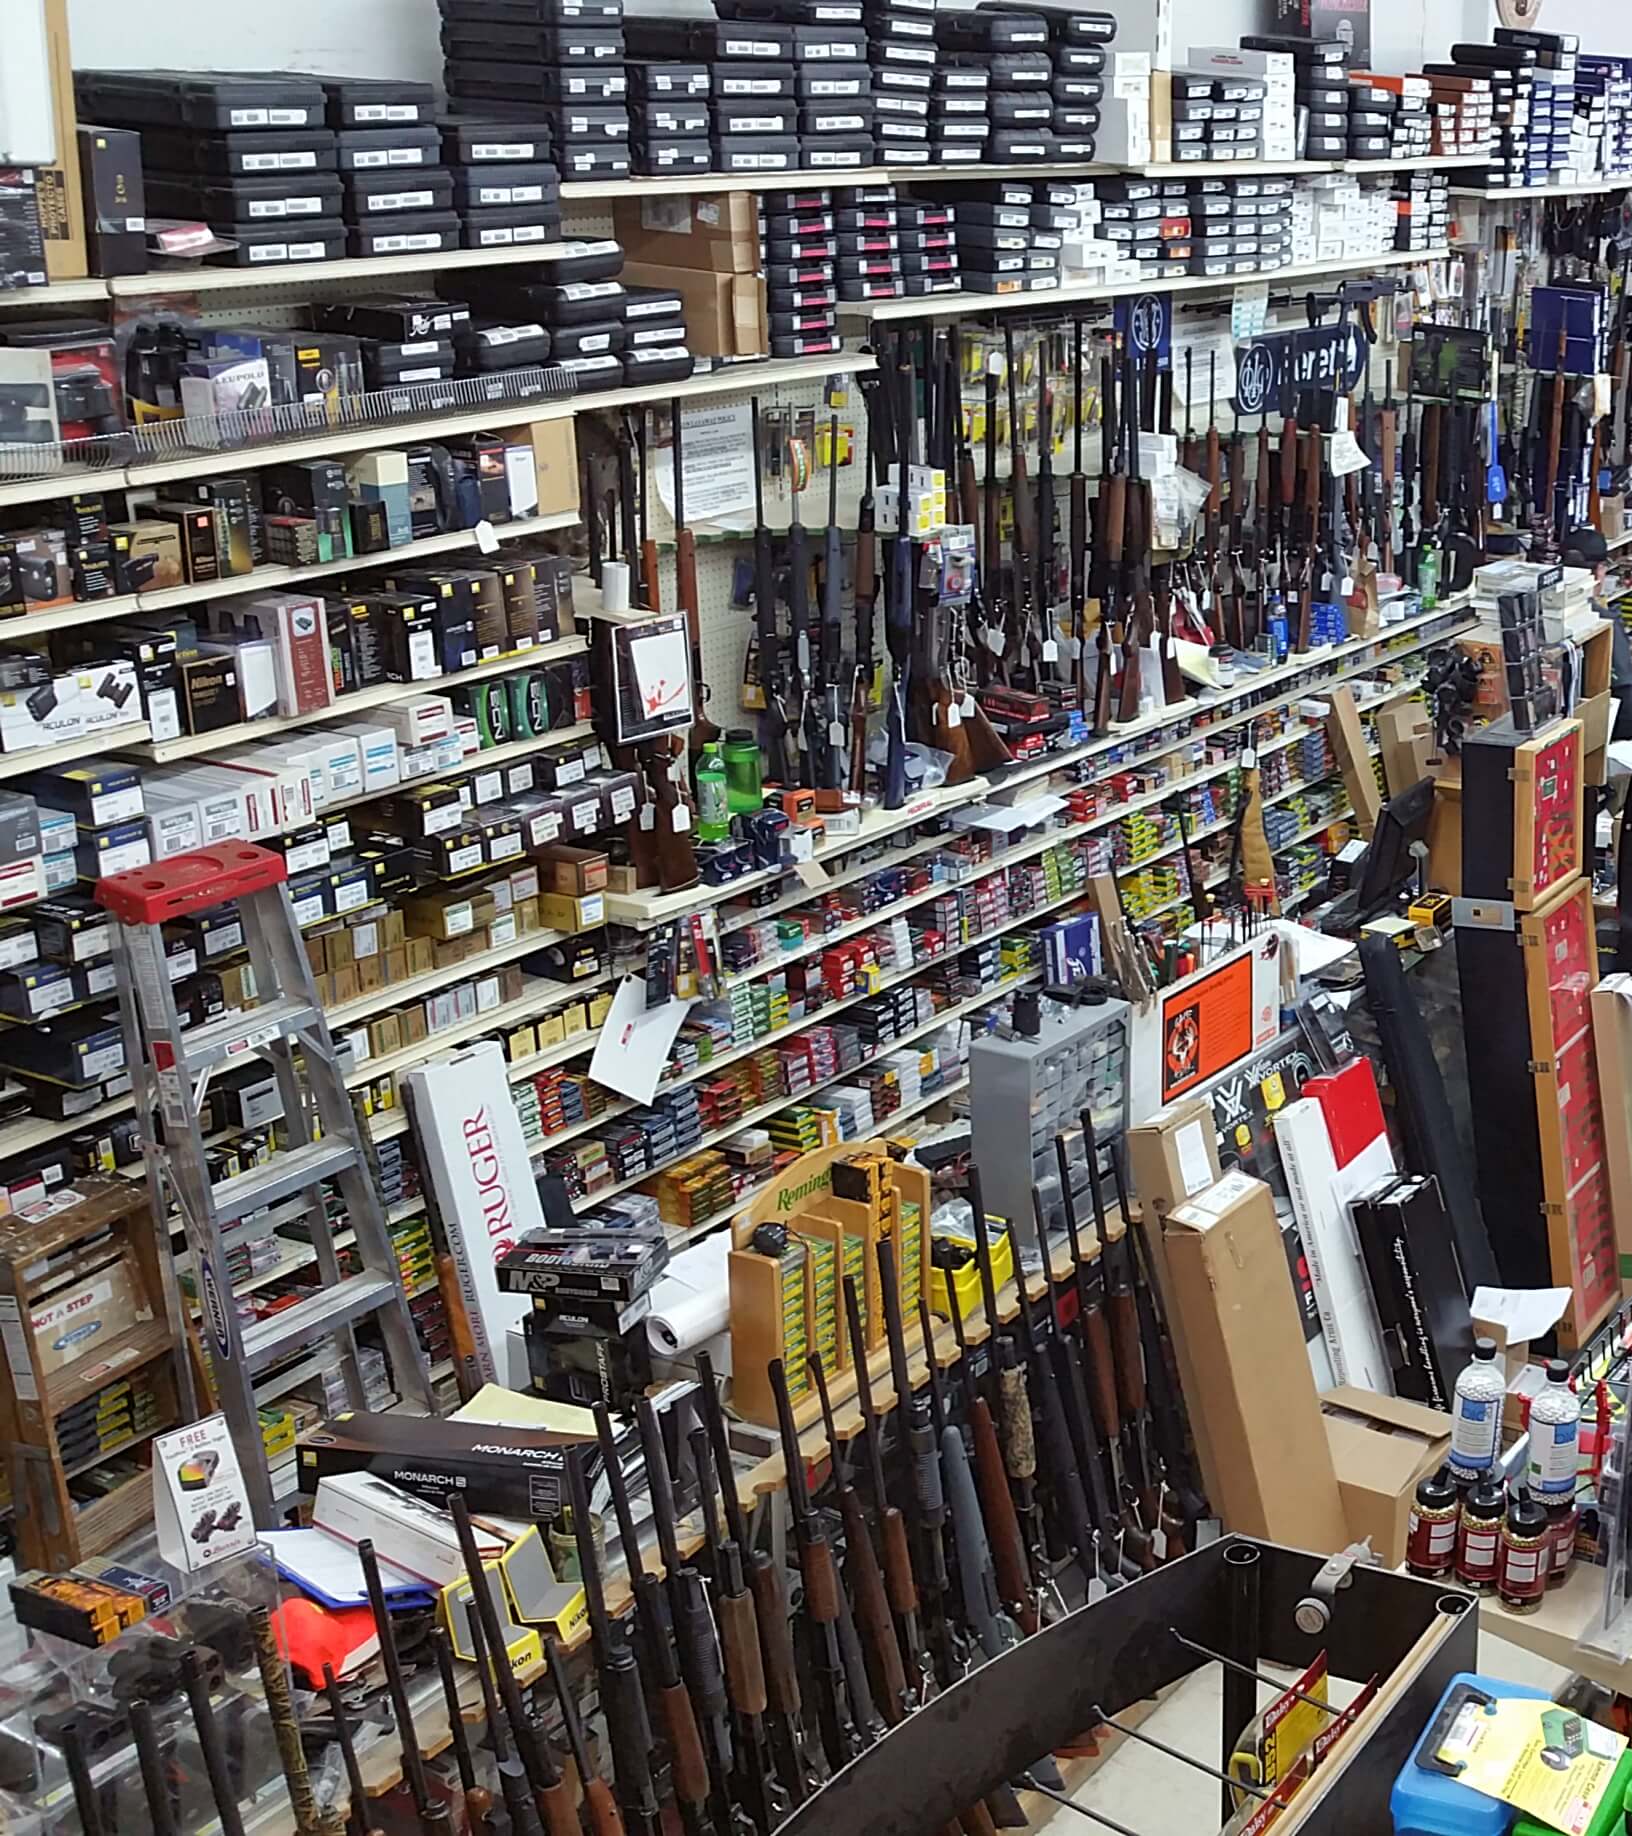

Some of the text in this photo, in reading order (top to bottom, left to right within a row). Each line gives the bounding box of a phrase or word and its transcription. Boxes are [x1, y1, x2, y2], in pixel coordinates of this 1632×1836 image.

[56, 187, 67, 224] CASES
[215, 371, 265, 386] LEUPOLD
[191, 675, 223, 690] Nikon
[42, 715, 81, 731] ACULON
[85, 711, 117, 724] ACULON
[1260, 1050, 1300, 1079] VORTEX
[1221, 1109, 1255, 1134] VORTEX
[462, 1103, 513, 1238] RUGER
[776, 1166, 833, 1212] Reming
[1302, 1213, 1316, 1248] America
[447, 1222, 477, 1303] RUGER.COM
[508, 1270, 561, 1292] M&P
[65, 1292, 94, 1312] STEP
[203, 1275, 225, 1342] WERNER
[1404, 1289, 1423, 1326] everyone's
[558, 1314, 589, 1324] ACULON
[1328, 1324, 1339, 1345] Arms
[1418, 1337, 1433, 1370] handling
[595, 1341, 611, 1403] PROSTAFF
[180, 1429, 208, 1448] FREE
[471, 1443, 557, 1461] MONARCH
[394, 1470, 454, 1486] MONARCH
[567, 1607, 588, 1631] Niko
[511, 1649, 532, 1671] kon
[1265, 1698, 1291, 1730] Daisy
[1316, 1723, 1342, 1752] Daisy
